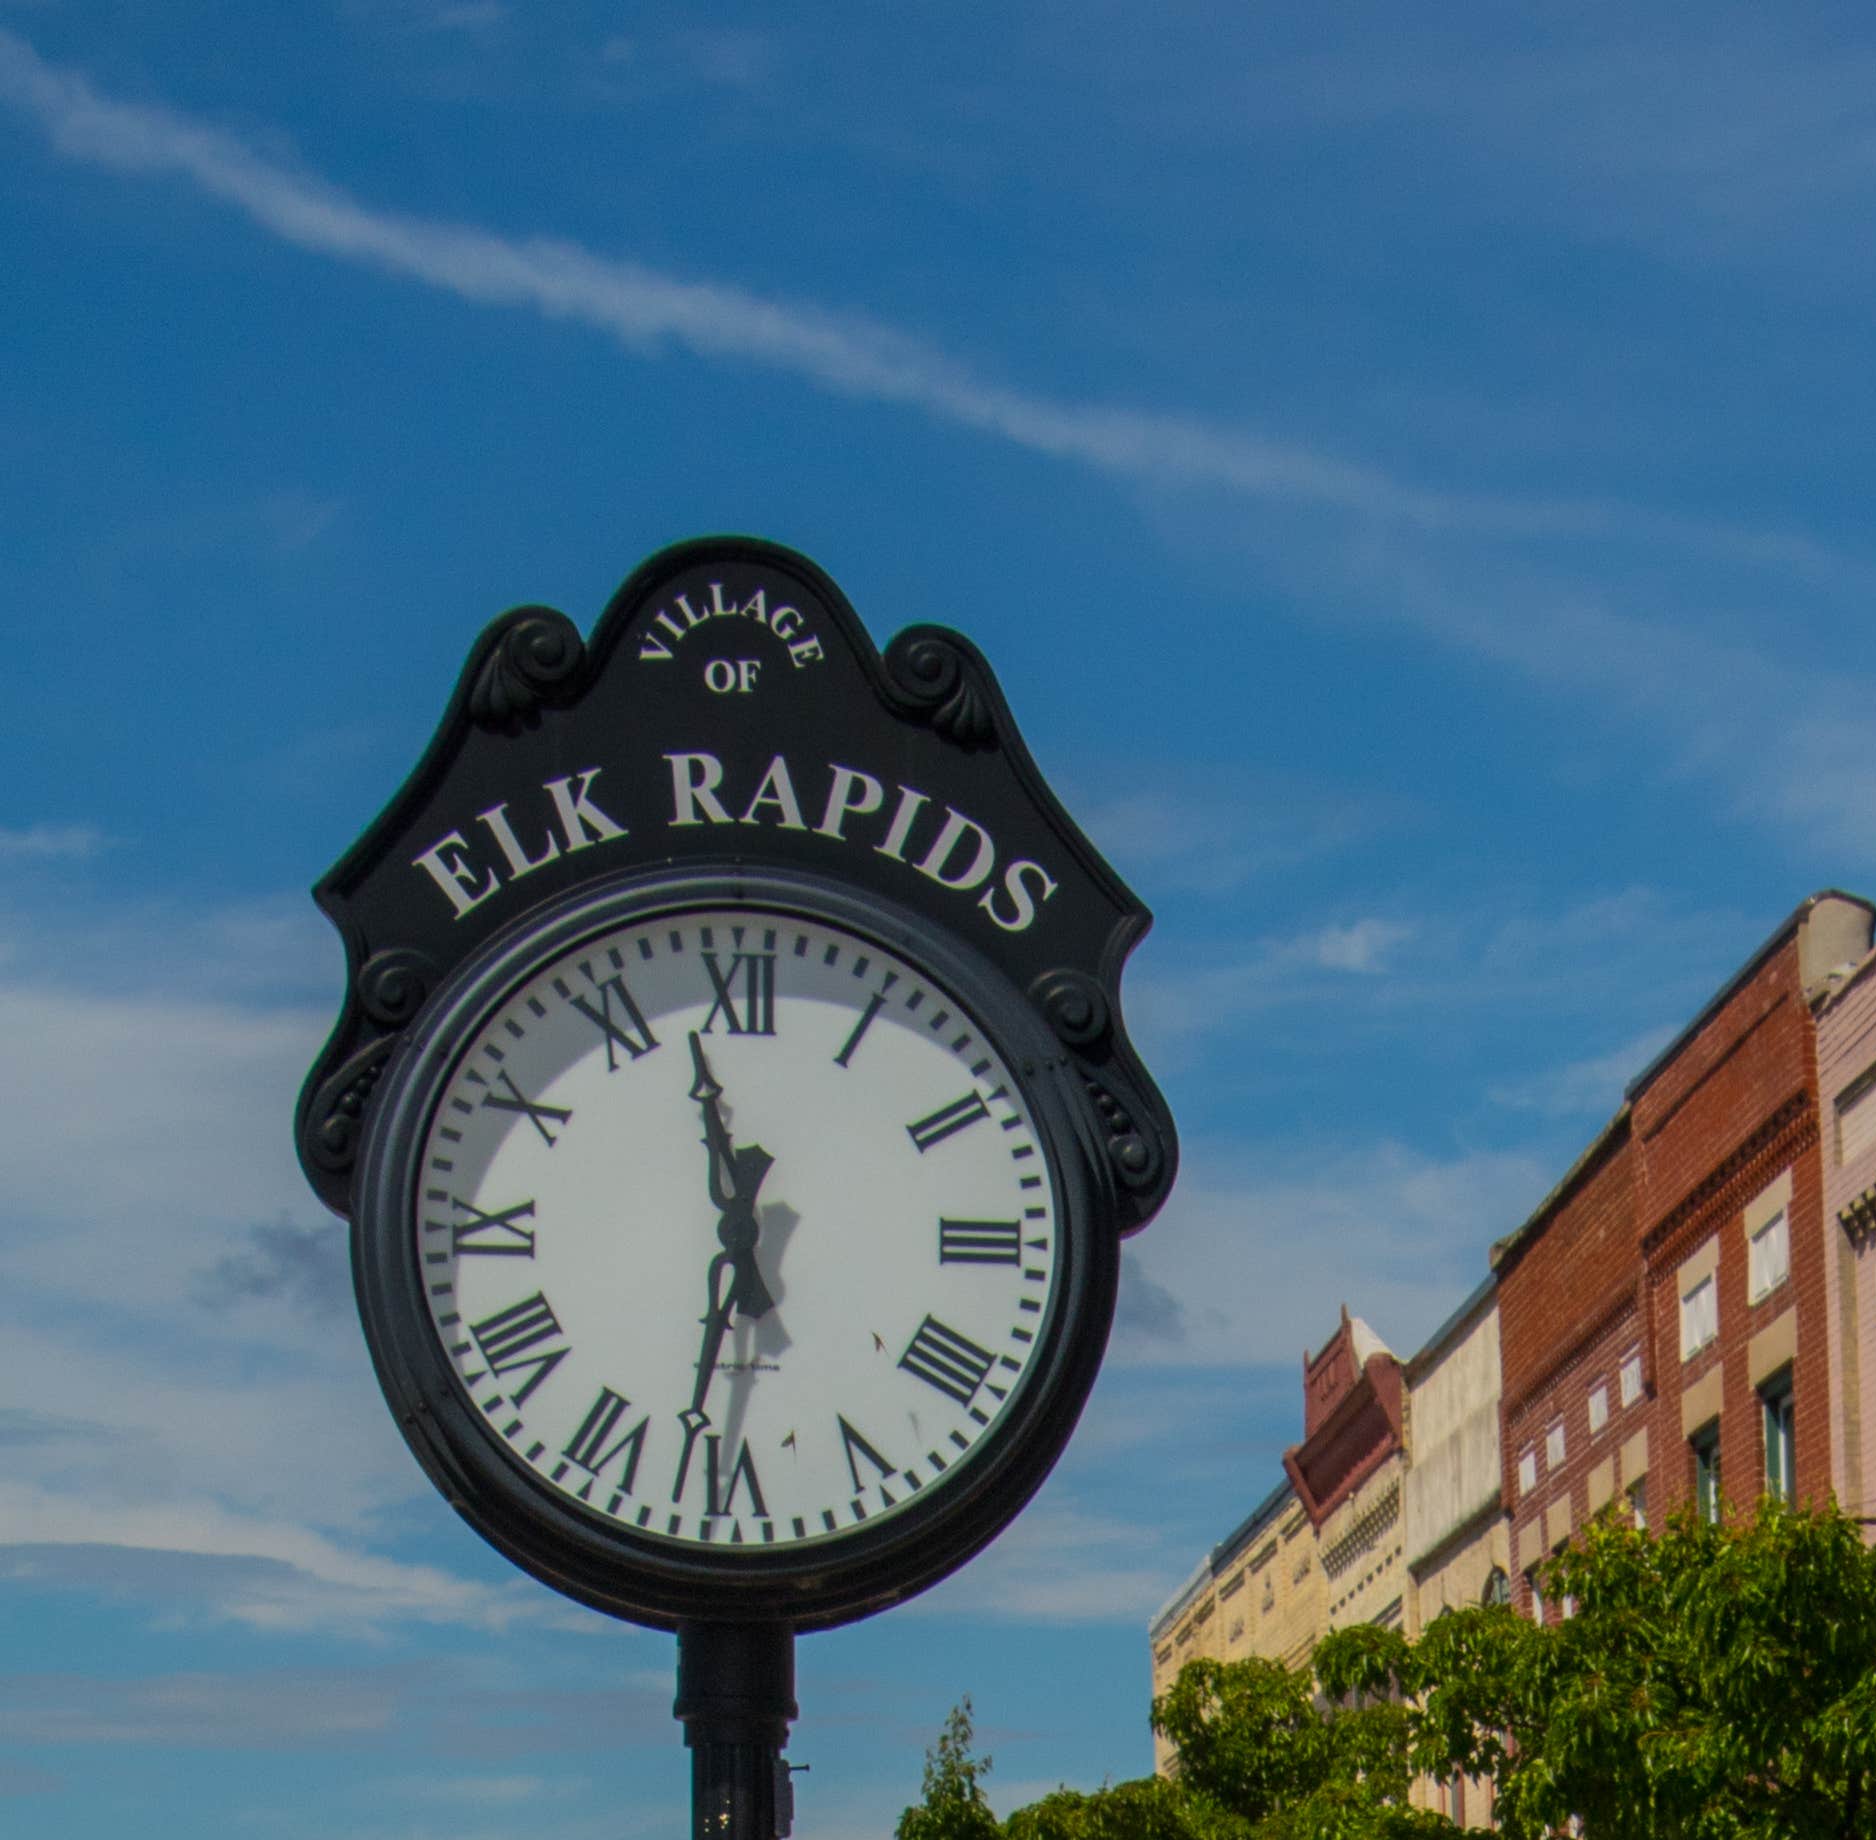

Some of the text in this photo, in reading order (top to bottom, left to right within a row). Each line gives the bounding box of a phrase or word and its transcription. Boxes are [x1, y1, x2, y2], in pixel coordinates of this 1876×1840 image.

[638, 583, 826, 668] VILLAGE
[703, 658, 762, 693] OF
[411, 752, 1058, 933] ELK RAPIDS
[568, 974, 663, 1075] XI
[700, 951, 776, 1036] XII
[833, 991, 886, 1069] I
[481, 1069, 573, 1150] X
[904, 1088, 991, 1155] II
[938, 1216, 1022, 1266] III
